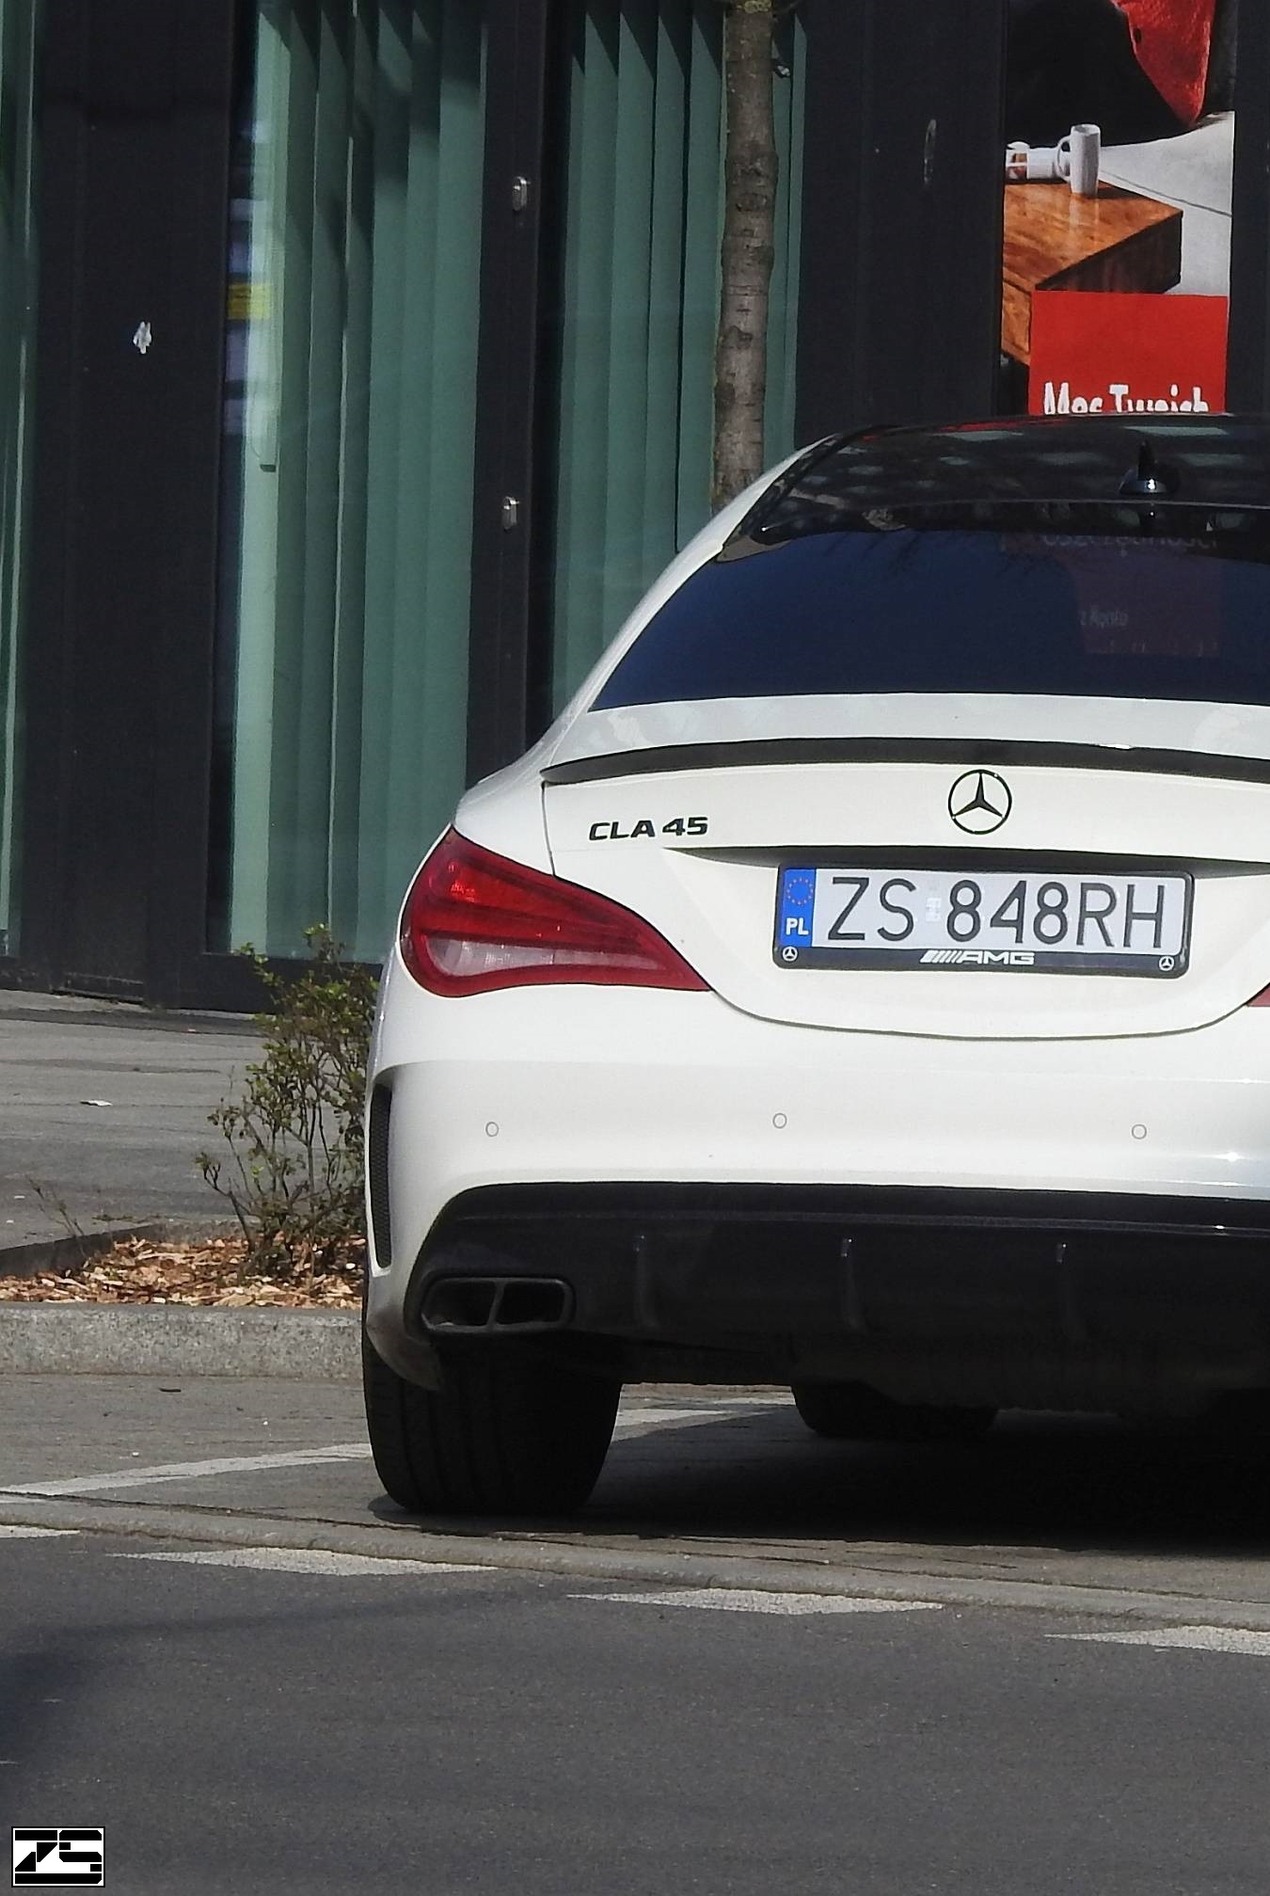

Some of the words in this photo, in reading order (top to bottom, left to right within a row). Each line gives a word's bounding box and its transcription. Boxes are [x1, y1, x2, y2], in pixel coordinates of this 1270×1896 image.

[589, 820, 656, 841] CLA
[662, 817, 708, 837] 45
[827, 876, 917, 942] ZS
[946, 879, 1166, 948] 848RH
[785, 917, 809, 936] PL
